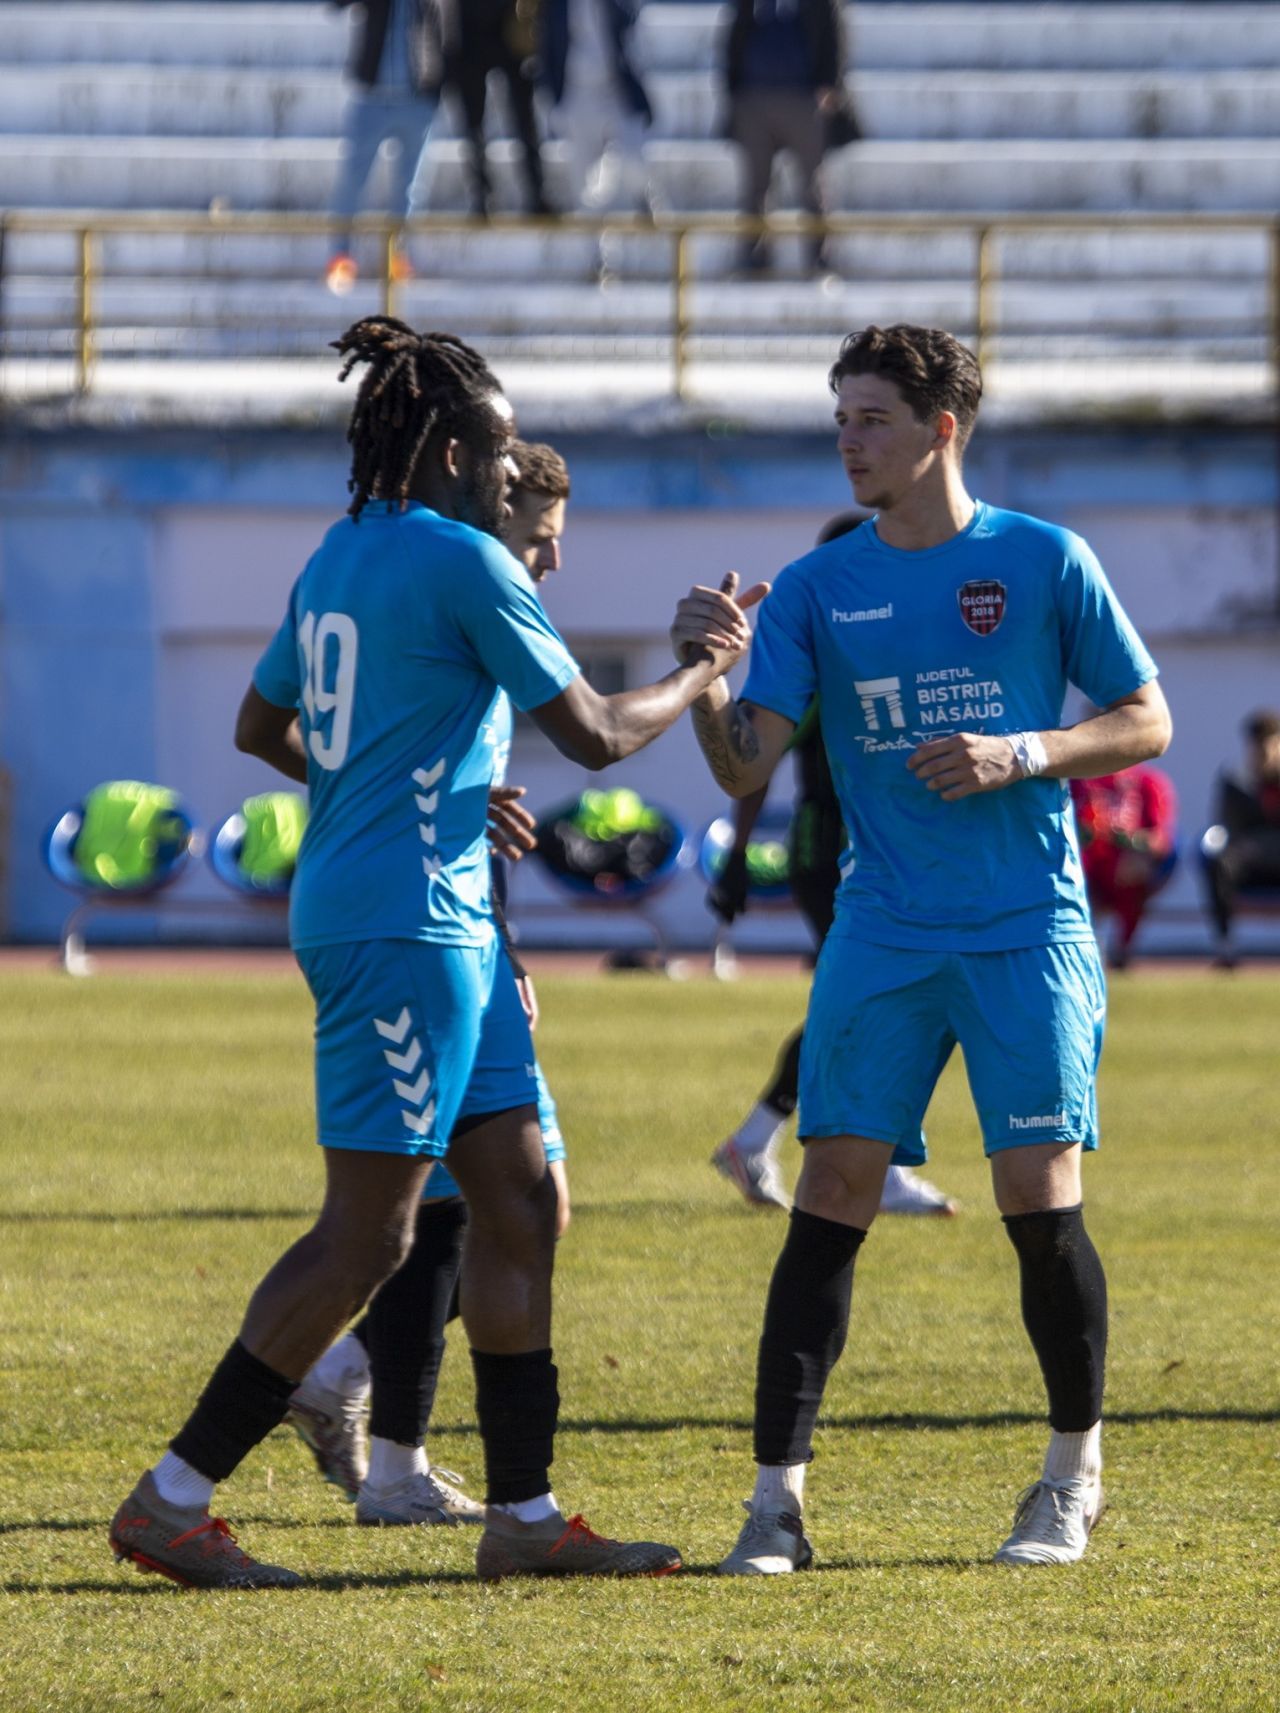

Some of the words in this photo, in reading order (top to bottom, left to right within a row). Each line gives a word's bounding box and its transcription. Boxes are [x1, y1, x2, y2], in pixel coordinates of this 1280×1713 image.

[961, 594, 1002, 606] GLORIA
[832, 602, 892, 623] hummel
[970, 606, 994, 616] 2018
[300, 610, 358, 770] 19
[920, 702, 1004, 725] NĂSĂUD
[854, 733, 916, 753] Poarta
